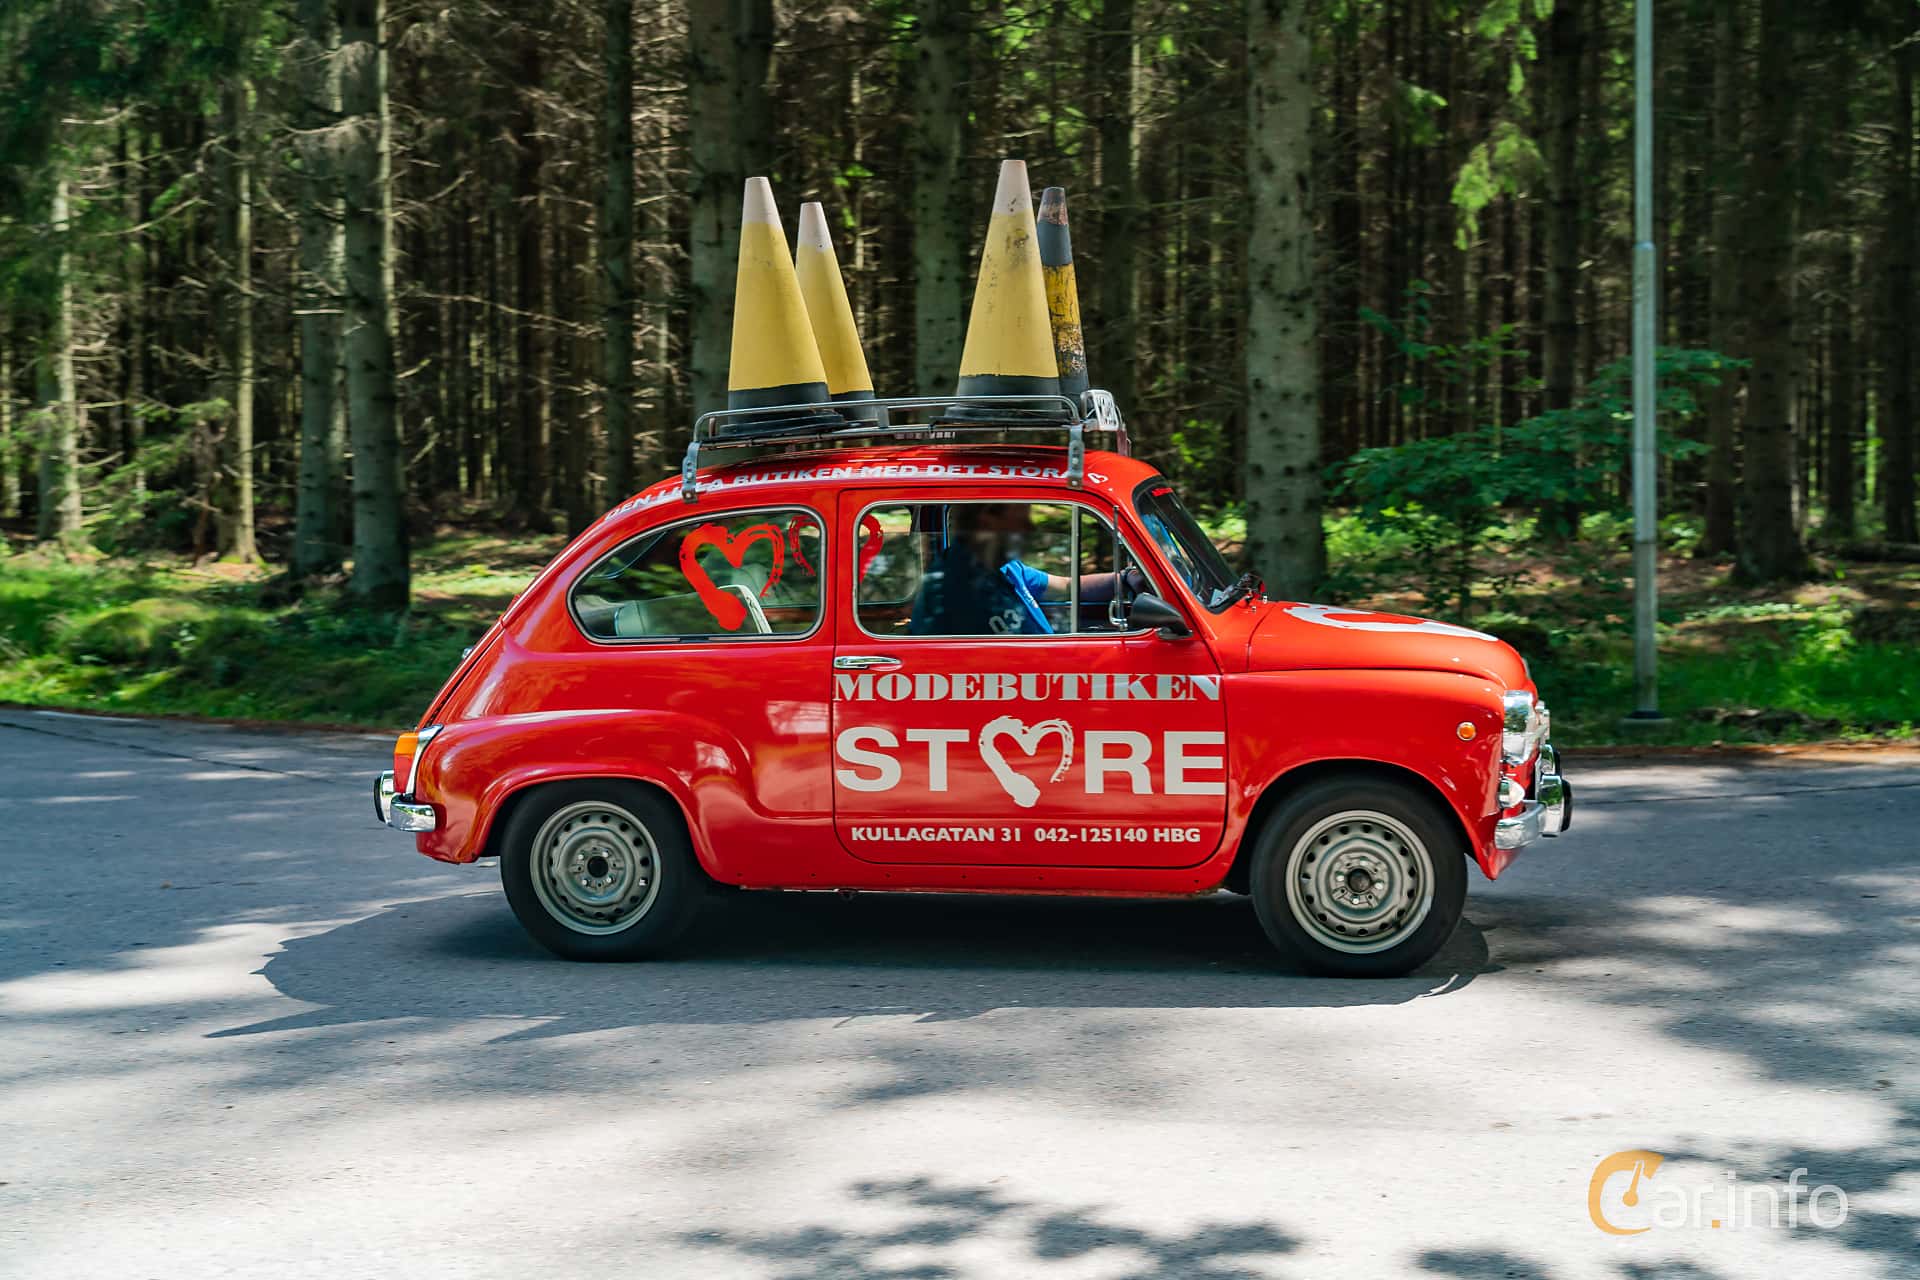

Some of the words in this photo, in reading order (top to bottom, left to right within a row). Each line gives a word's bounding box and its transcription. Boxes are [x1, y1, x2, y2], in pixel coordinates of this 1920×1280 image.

[604, 492, 653, 520] DEN
[734, 467, 852, 487] BUTIKEN
[859, 465, 917, 479] MED
[926, 464, 982, 478] DET
[832, 673, 1222, 701] MODEBUTIKEN
[851, 827, 995, 842] KULLAGATAN
[1000, 827, 1021, 842] 31
[1034, 828, 1148, 842] 042-125140
[1153, 828, 1201, 842] HBG
